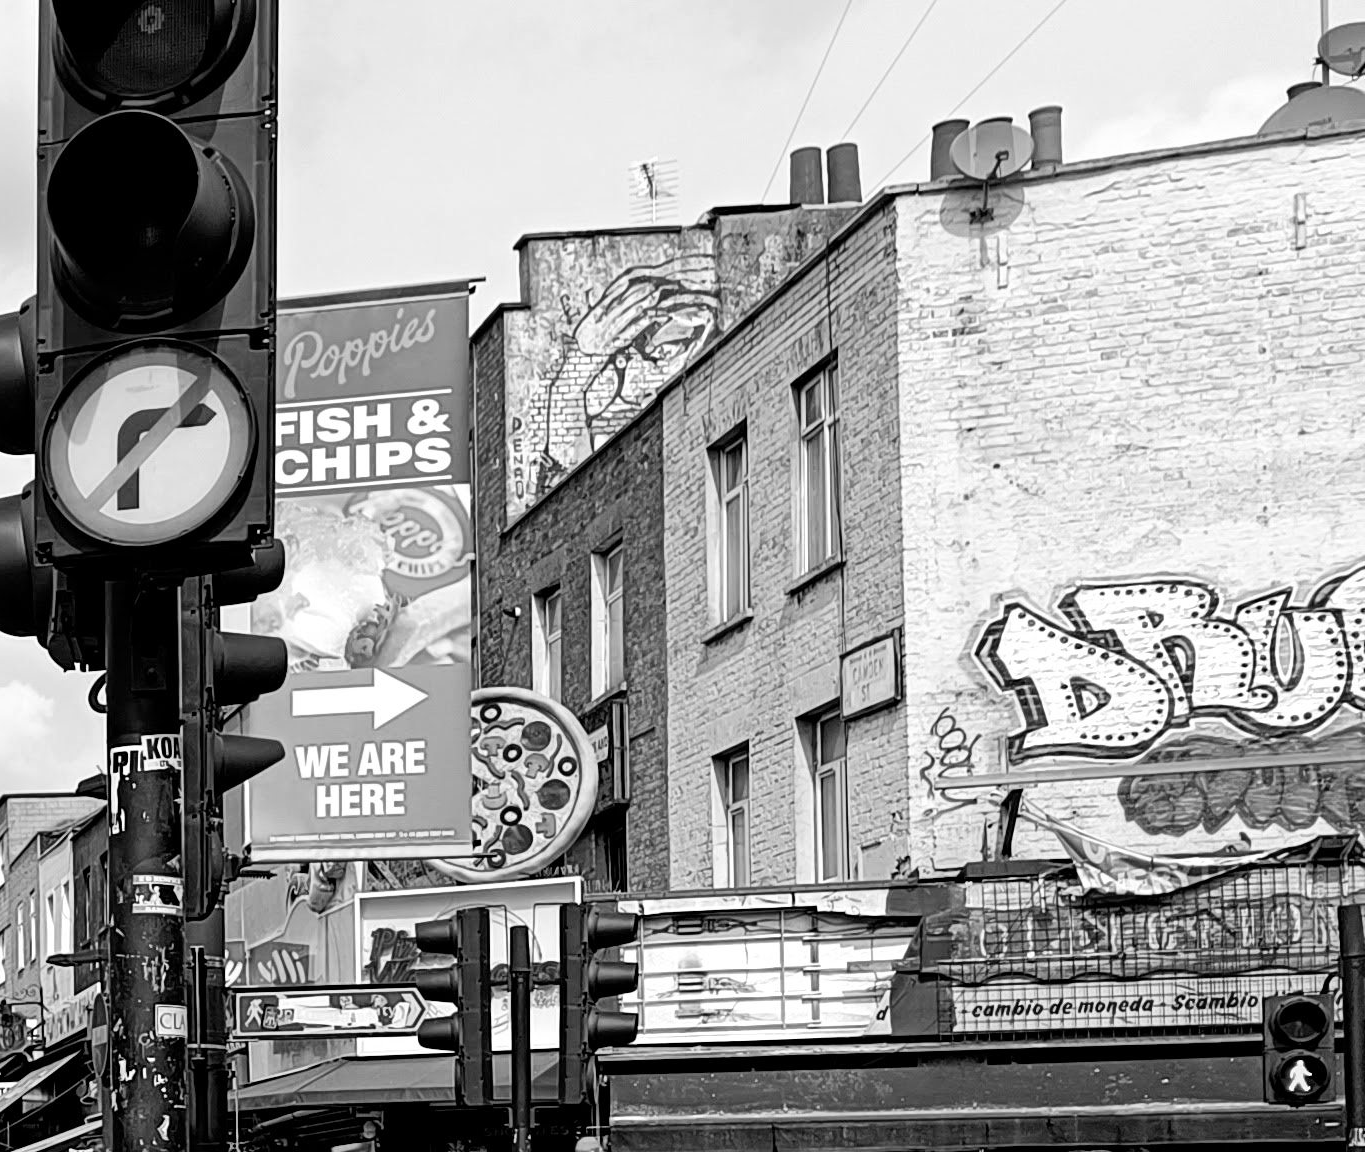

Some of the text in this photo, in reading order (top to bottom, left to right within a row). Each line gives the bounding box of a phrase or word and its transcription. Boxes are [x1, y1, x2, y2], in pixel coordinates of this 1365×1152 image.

[283, 307, 436, 399] Poppies
[276, 399, 451, 447] FISH &
[275, 437, 452, 485] CHIPS
[295, 740, 427, 781] WE ARE
[315, 782, 405, 818] HERE
[971, 992, 1259, 1022] cambio de moneda Scambio
